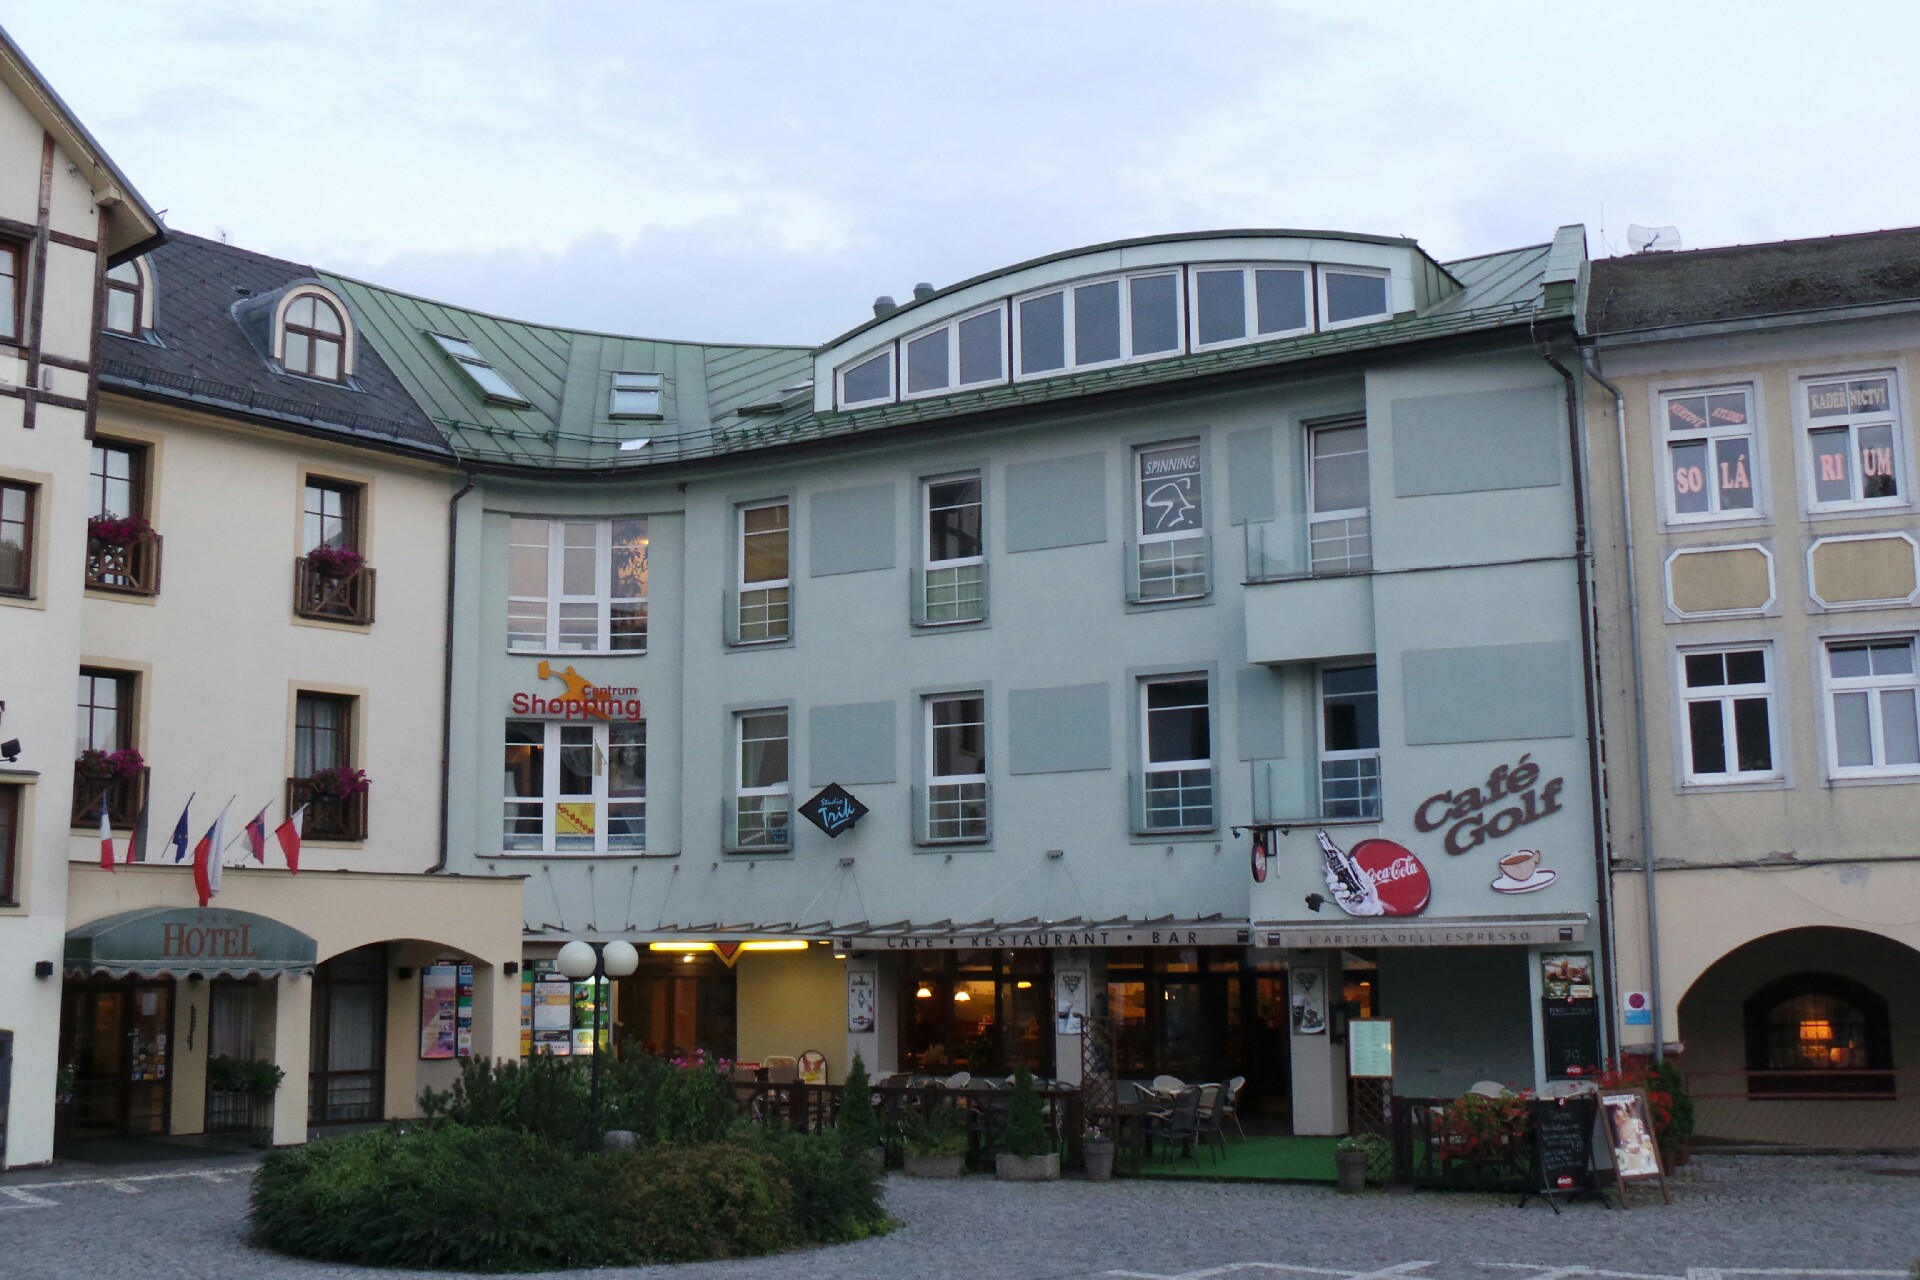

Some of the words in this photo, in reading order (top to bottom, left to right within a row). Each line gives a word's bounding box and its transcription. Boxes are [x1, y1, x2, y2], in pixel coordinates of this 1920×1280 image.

[1145, 455, 1197, 475] SPINNING
[582, 684, 639, 696] Centrum
[512, 692, 642, 721] Shopping
[1414, 752, 1540, 833] Café
[1444, 777, 1564, 856] Golf
[161, 922, 257, 958] HOTEL
[971, 932, 1109, 947] RESTAURANT
[1152, 931, 1199, 945] BAR
